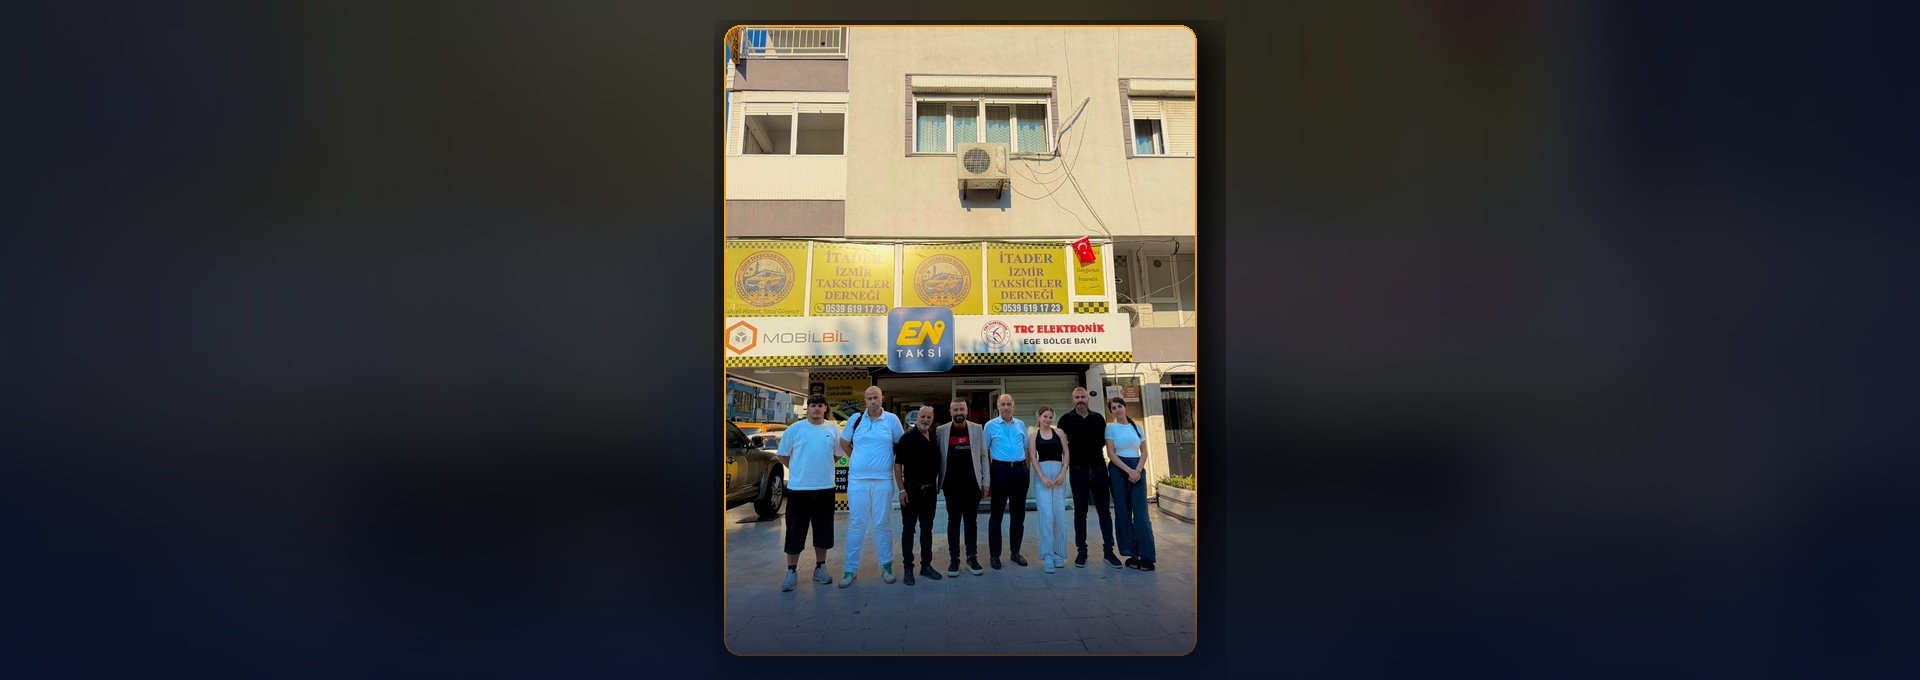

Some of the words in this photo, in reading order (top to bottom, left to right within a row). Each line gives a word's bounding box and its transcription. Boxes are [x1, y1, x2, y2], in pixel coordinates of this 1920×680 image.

[826, 250, 882, 264] İTADER
[999, 251, 1053, 264] İTADER
[835, 265, 872, 277] İZMİR
[1009, 266, 1044, 277] İZMİR
[816, 278, 889, 289] TAKSİCİLER
[992, 278, 1062, 288] TAKSİCİLER
[825, 290, 880, 300] DERNEĞİ
[1001, 289, 1054, 300] DERNEĞİ
[825, 304, 845, 313] 0539
[847, 304, 862, 313] 619
[864, 305, 873, 313] 17
[876, 305, 886, 314] 23
[1002, 304, 1021, 312] 0539
[1023, 304, 1038, 312] 619
[1040, 304, 1049, 312] 17
[1051, 304, 1061, 312] 23
[896, 320, 946, 346] EN
[1014, 325, 1035, 334] TRC
[1037, 322, 1105, 334] ELEKTRONİK
[1043, 337, 1072, 345] BÖLGE
[896, 347, 941, 358] TAKSİ
